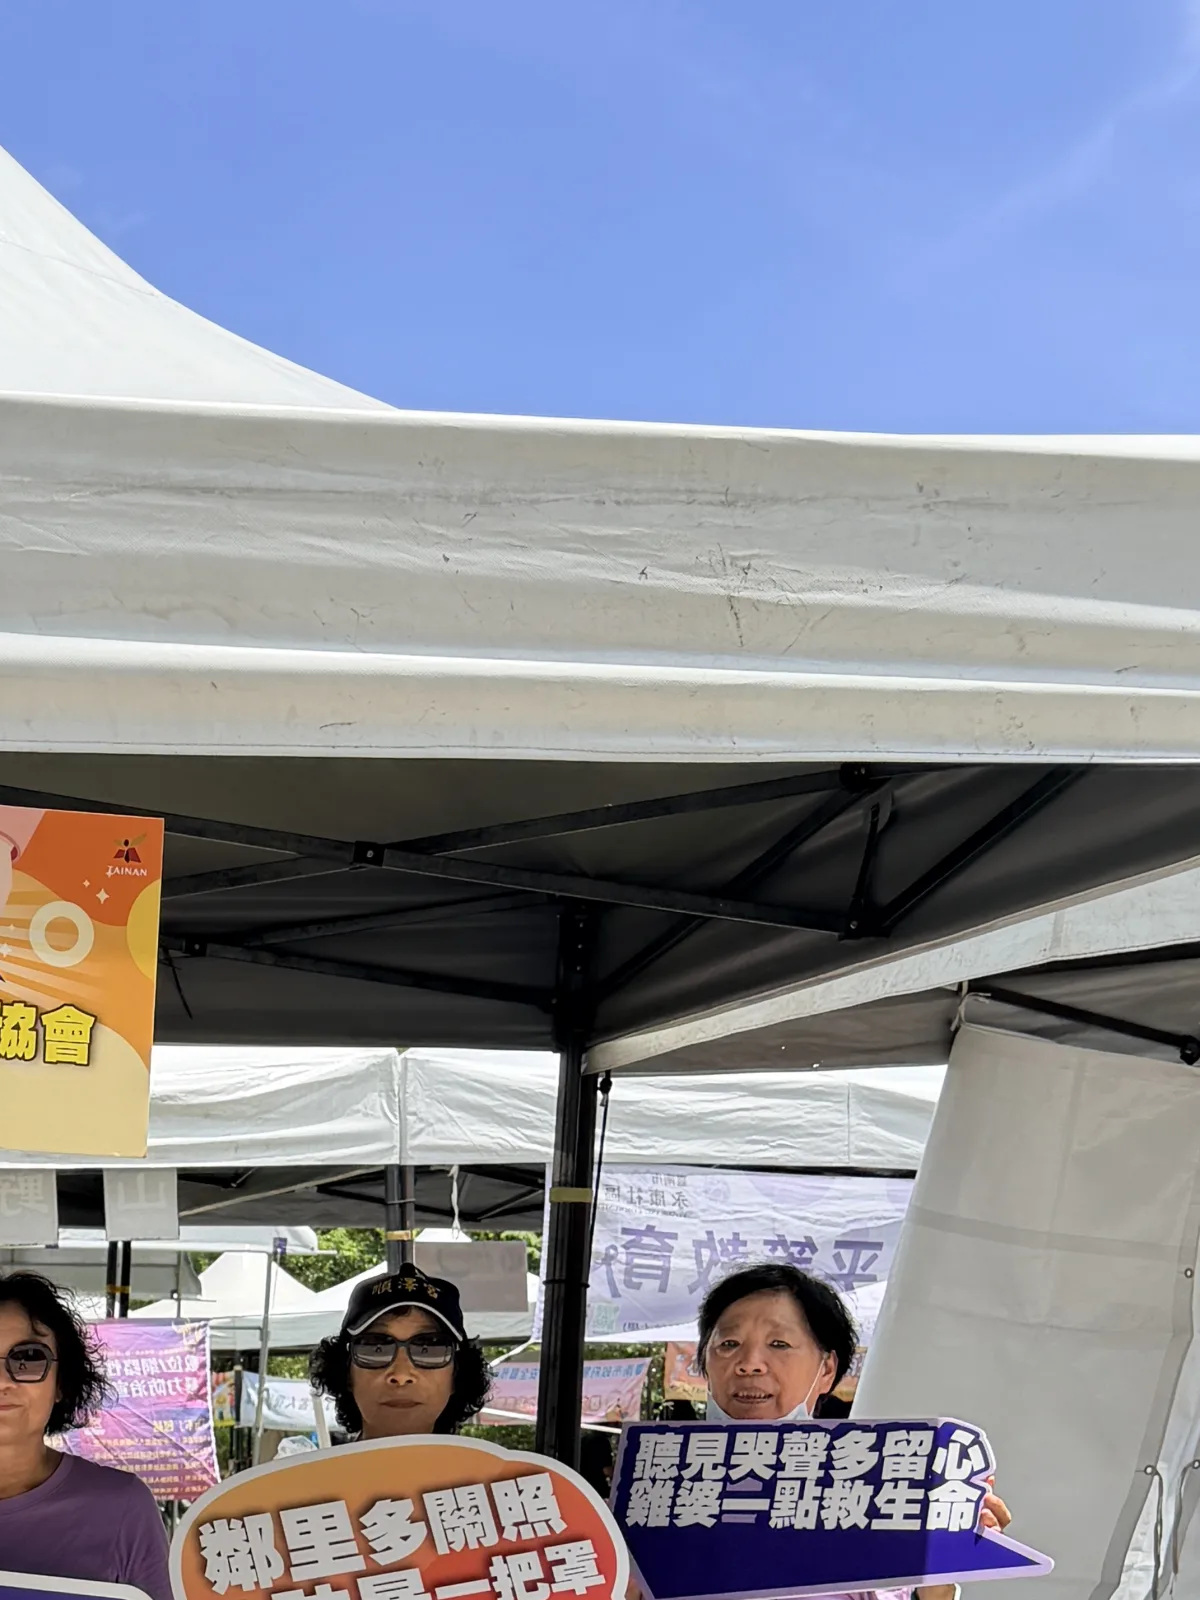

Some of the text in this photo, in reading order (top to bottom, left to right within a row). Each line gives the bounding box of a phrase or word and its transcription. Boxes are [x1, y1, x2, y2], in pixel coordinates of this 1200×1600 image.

[106, 865, 148, 877] TAINAN
[632, 1429, 988, 1482] 聽見哭聲多留心
[625, 1479, 988, 1533] 雞婆一點救生命
[198, 1472, 568, 1597] 鄰里多關照
